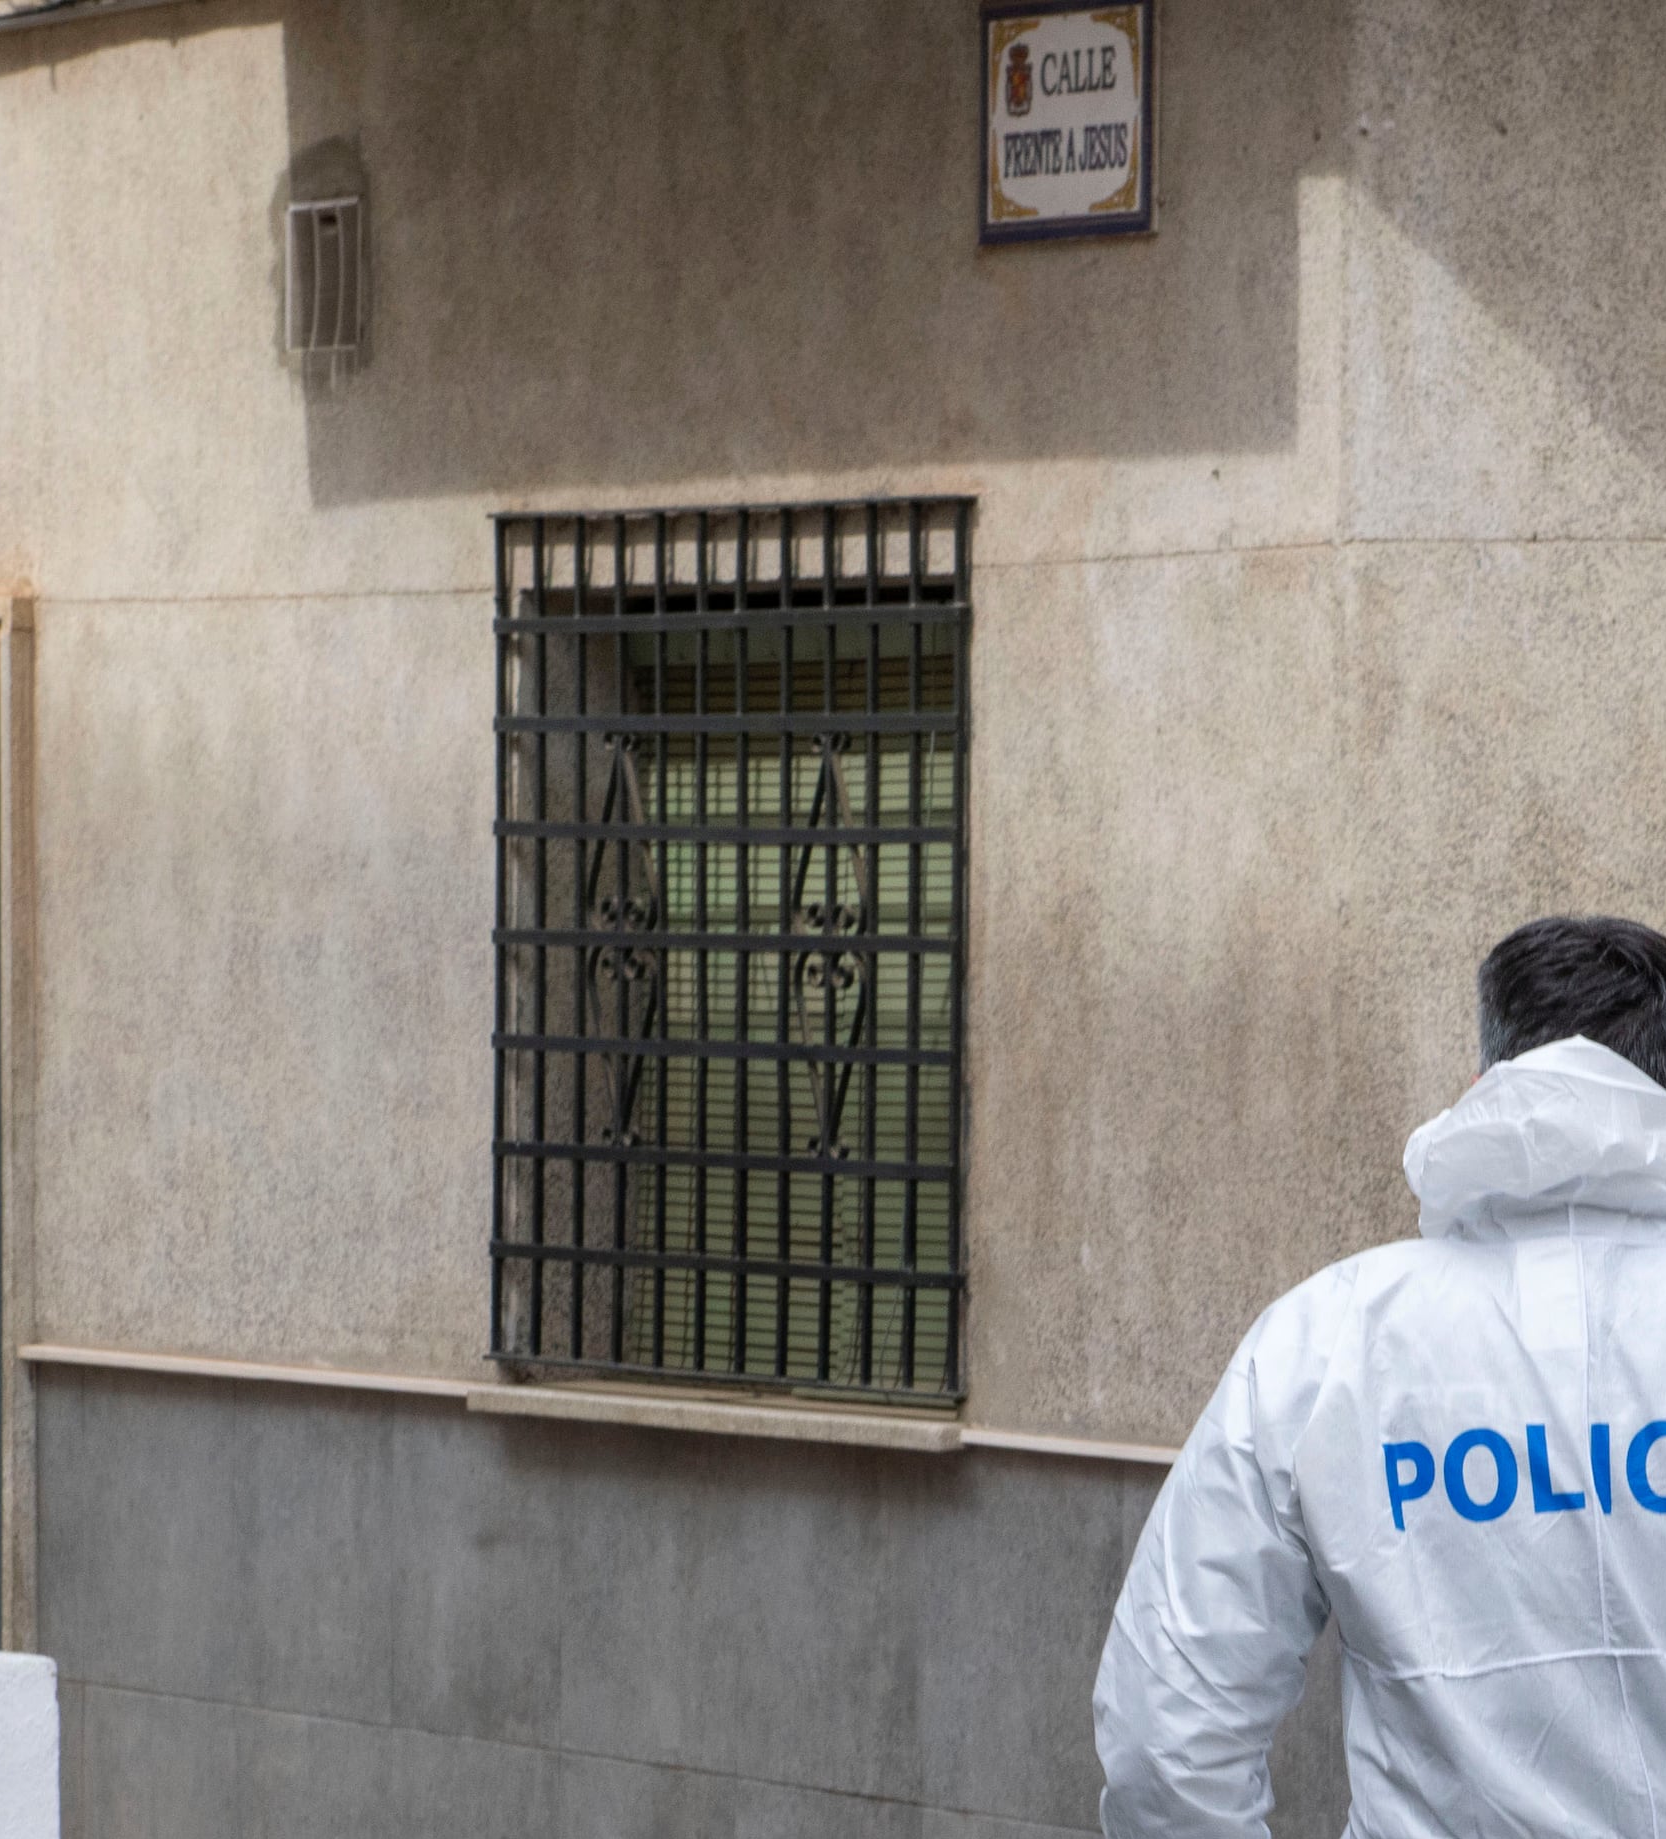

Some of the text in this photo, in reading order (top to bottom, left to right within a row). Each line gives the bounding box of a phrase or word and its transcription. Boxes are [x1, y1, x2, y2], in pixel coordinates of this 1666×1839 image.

[1040, 45, 1117, 97] CALLE
[1004, 122, 1128, 179] FRENTE A JESUS
